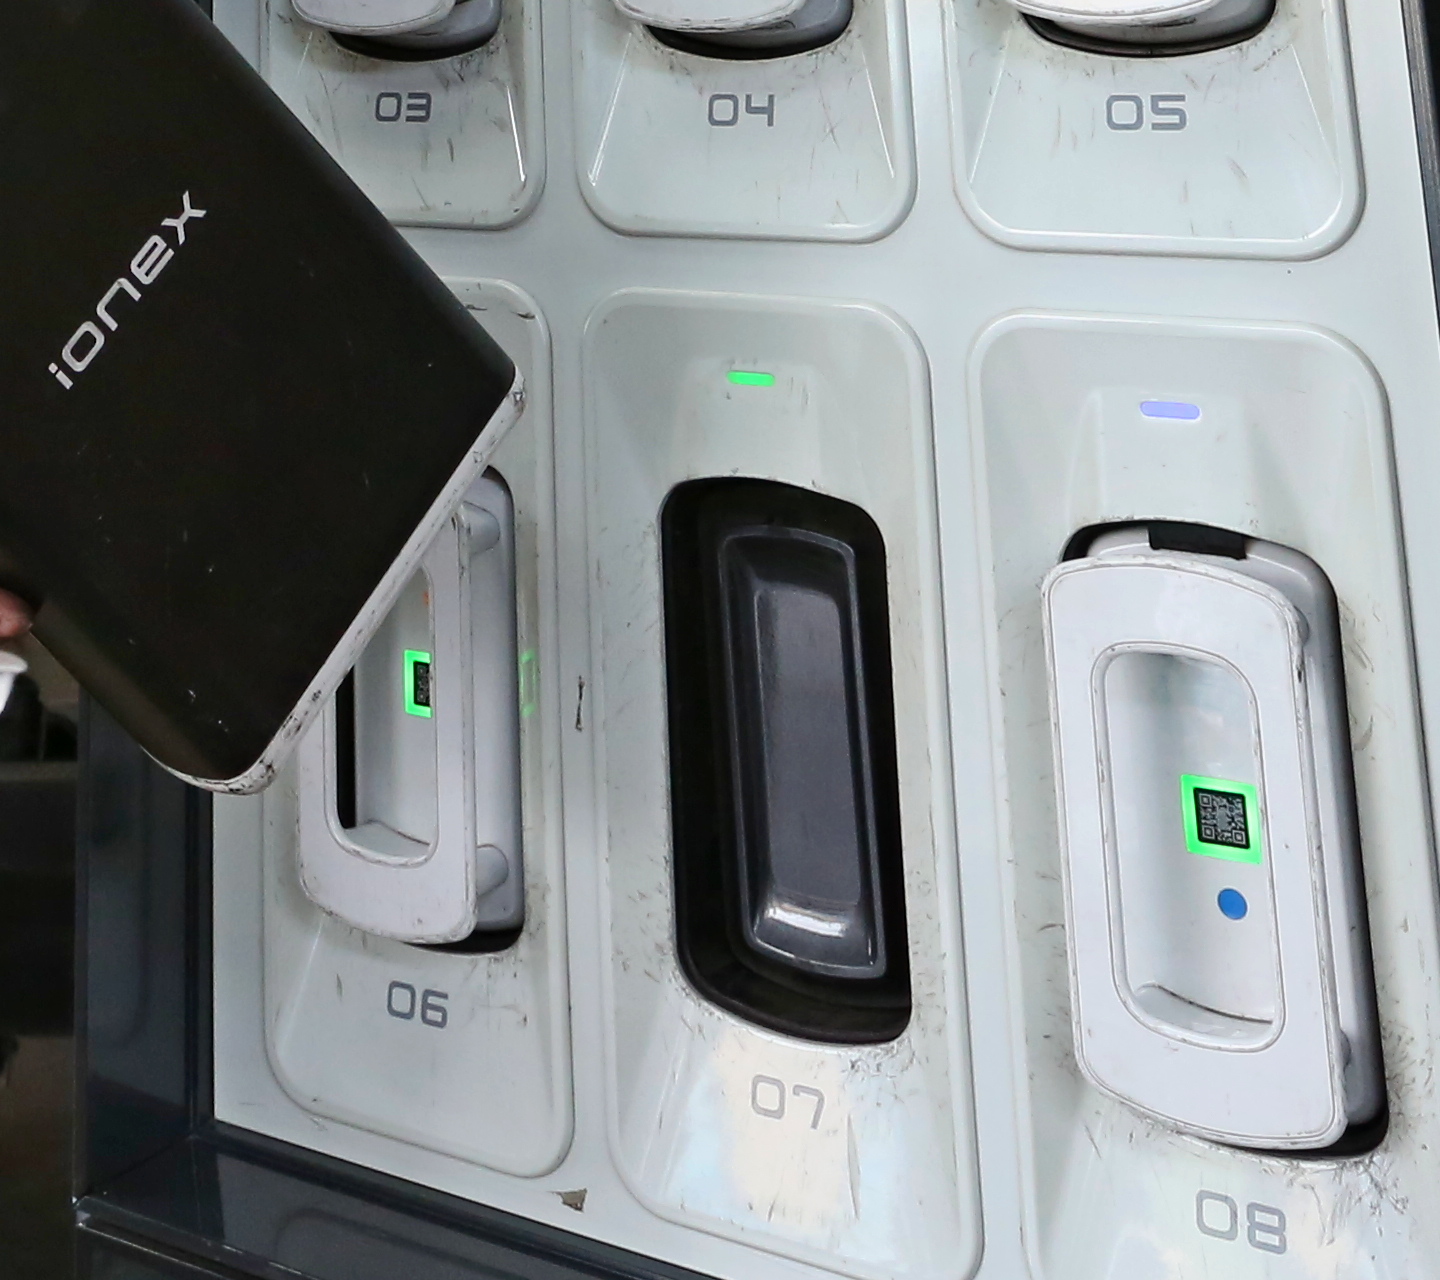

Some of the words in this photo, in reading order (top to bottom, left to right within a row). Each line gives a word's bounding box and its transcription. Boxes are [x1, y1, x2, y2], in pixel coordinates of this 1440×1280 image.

[374, 92, 433, 124] 03
[707, 94, 776, 129] 04
[1104, 94, 1189, 132] 05
[48, 190, 207, 390] ionex
[386, 980, 450, 1030] 06
[750, 1073, 825, 1131] 07
[1195, 1188, 1288, 1256] 08
